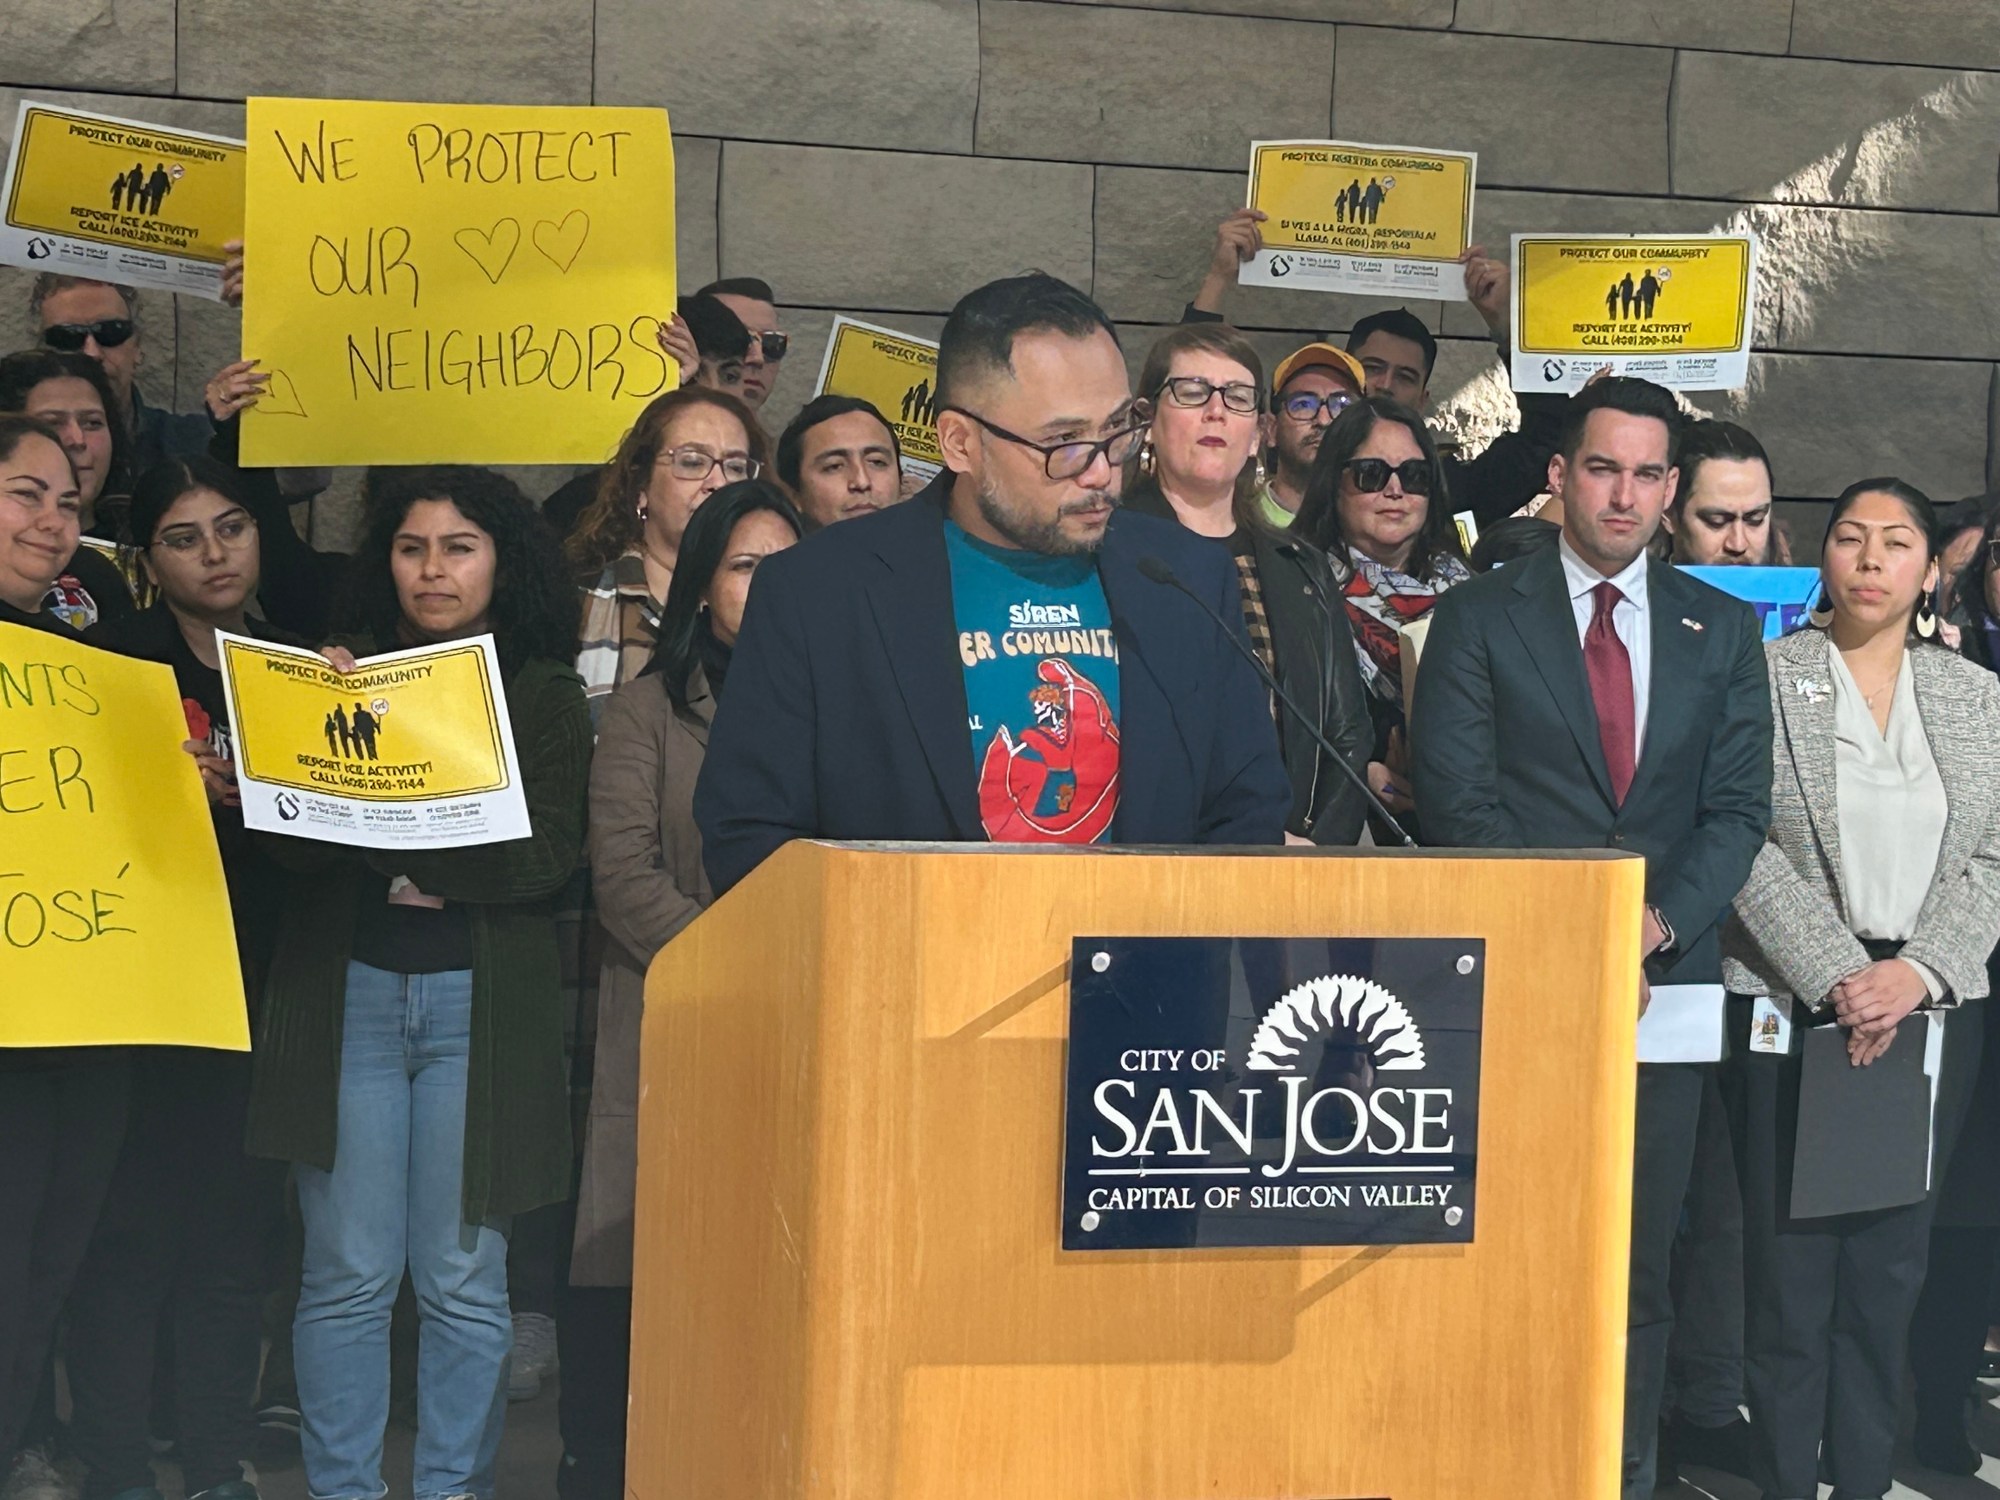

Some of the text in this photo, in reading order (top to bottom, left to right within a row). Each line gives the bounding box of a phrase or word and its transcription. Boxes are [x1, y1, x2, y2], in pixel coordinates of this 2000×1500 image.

[69, 124, 124, 144] PROTECT
[275, 120, 631, 184] WE PROTECT
[70, 206, 118, 224] REPORT
[78, 220, 108, 235] CALL
[1560, 248, 1610, 258] PROTECT
[310, 226, 418, 308] OUR
[1582, 335, 1609, 345] CALL
[348, 315, 668, 400] NEIGHBORS
[266, 659, 317, 680] PROTECT
[320, 672, 344, 687] OUR
[345, 665, 433, 690] COMMUNITY
[297, 754, 341, 771] REPORT
[344, 763, 365, 775] ICE
[310, 771, 339, 785] CALL
[0, 862, 137, 948] OSÉ
[1119, 1049, 1226, 1072] CITY OF
[1091, 1076, 1454, 1178] SAN JOSE
[1088, 1184, 1453, 1210] CAPITAL OF SILICON VALLEY
